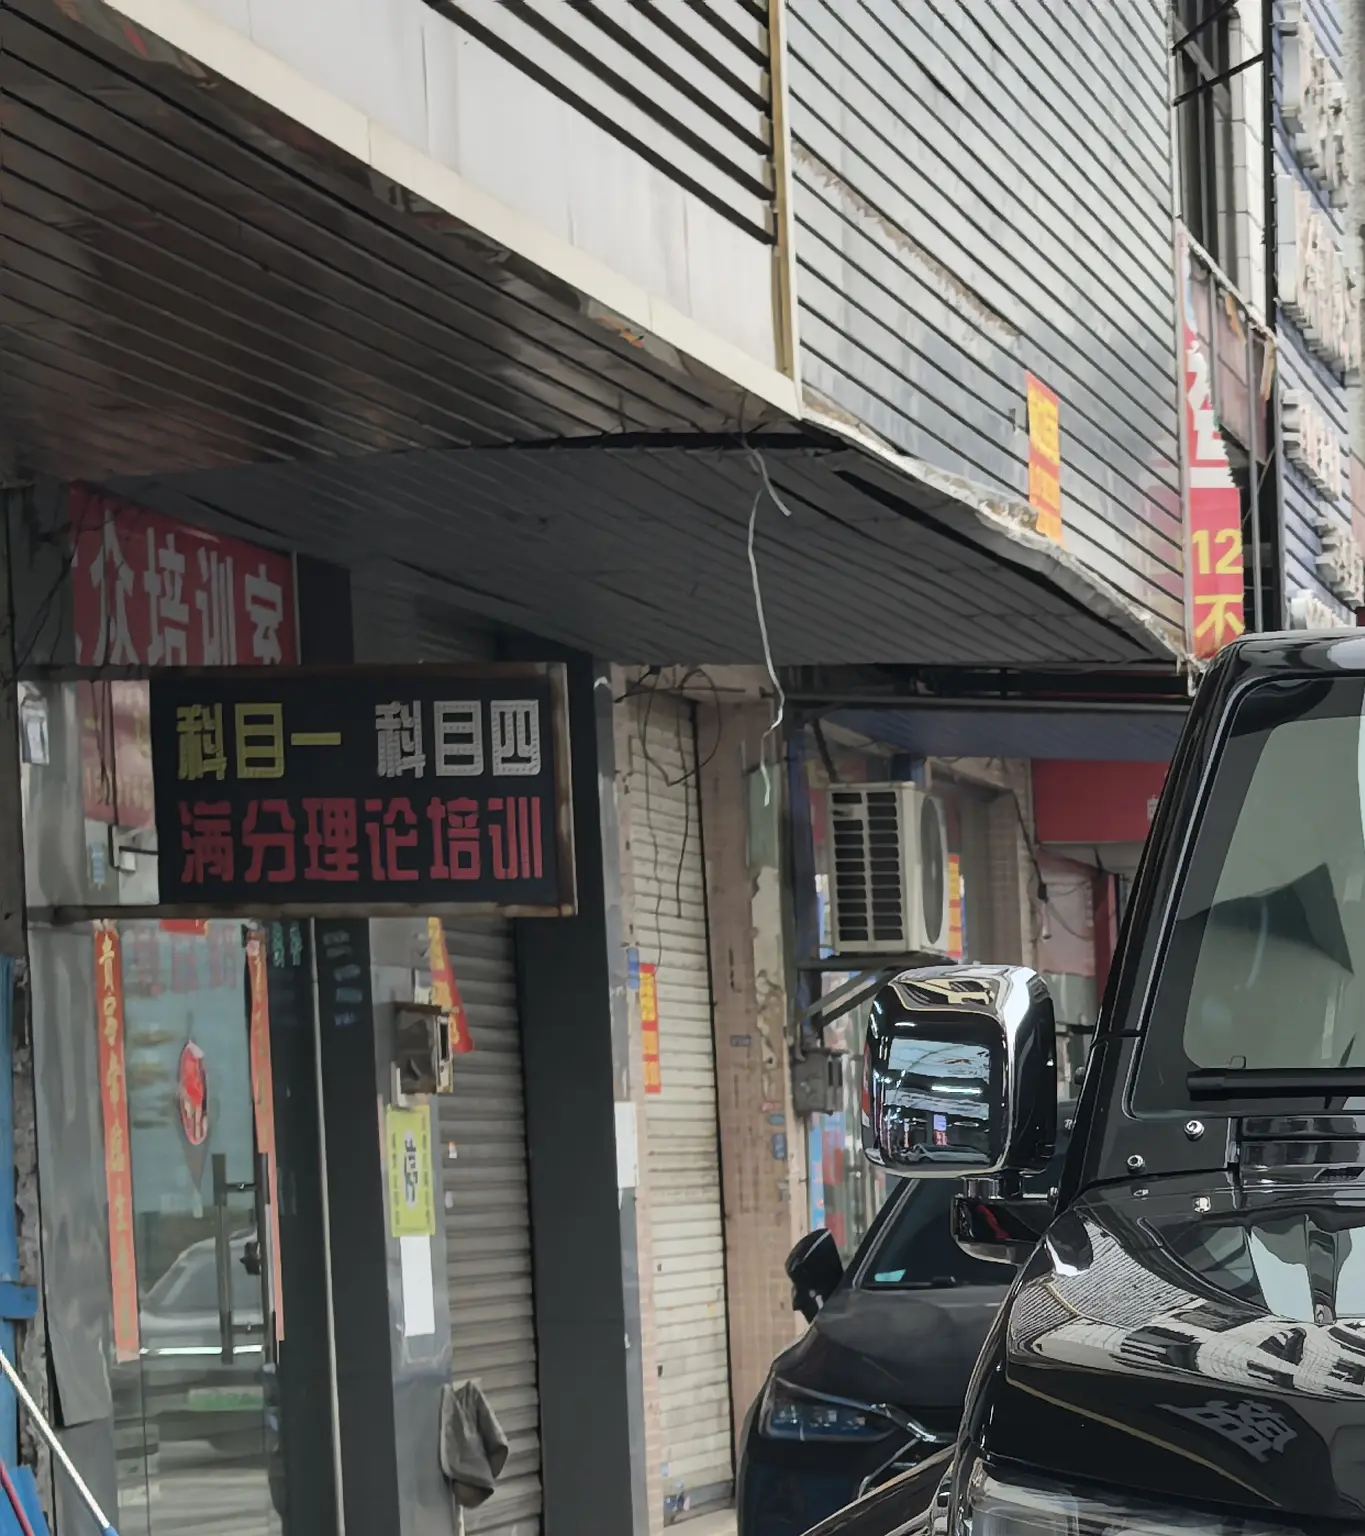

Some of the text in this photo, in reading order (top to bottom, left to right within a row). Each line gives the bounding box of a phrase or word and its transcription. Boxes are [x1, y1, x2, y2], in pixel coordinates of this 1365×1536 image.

[72, 508, 283, 666] 众培训室
[176, 702, 341, 780] 科目一
[375, 699, 542, 778] 科目四
[178, 796, 543, 884] 满分理论培训
